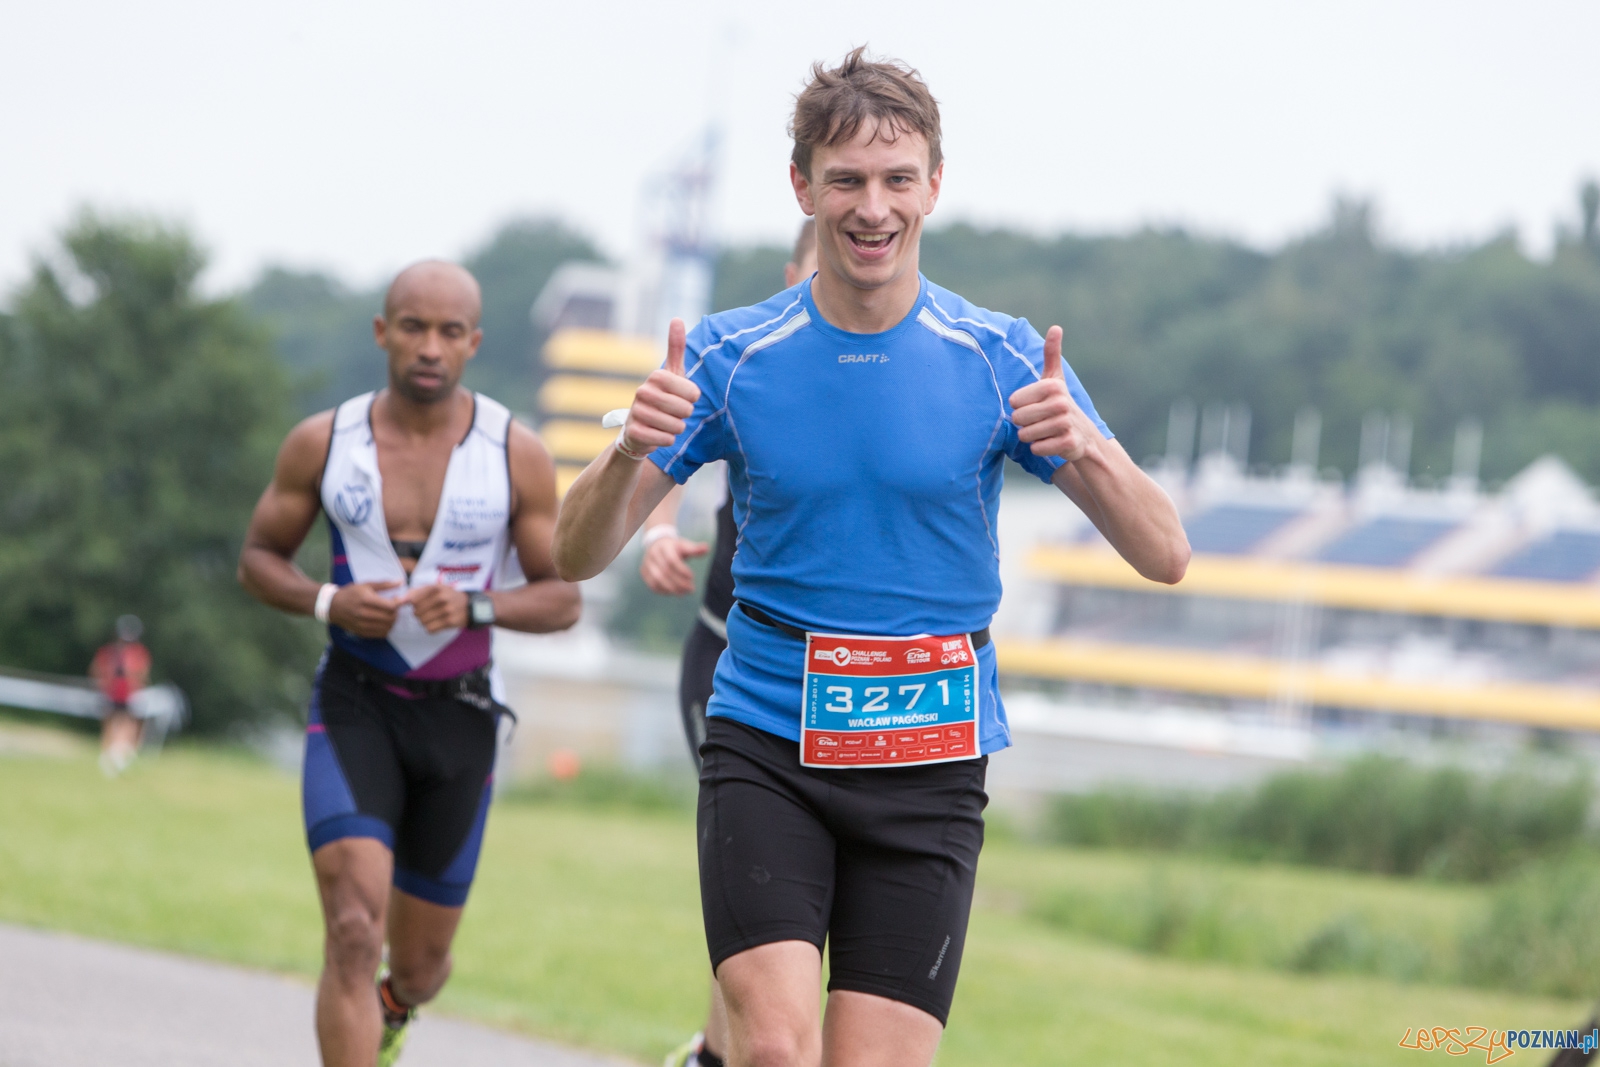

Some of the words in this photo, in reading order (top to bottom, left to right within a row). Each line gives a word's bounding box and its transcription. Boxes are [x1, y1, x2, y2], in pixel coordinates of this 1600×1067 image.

[838, 354, 879, 364] CRAFT
[907, 651, 931, 660] Enea
[810, 677, 819, 725] 23.07.2016
[825, 679, 950, 714] 3271
[848, 716, 891, 728] WACŁAW
[892, 712, 939, 726] PAGÓRSKI
[931, 934, 951, 971] karrimor
